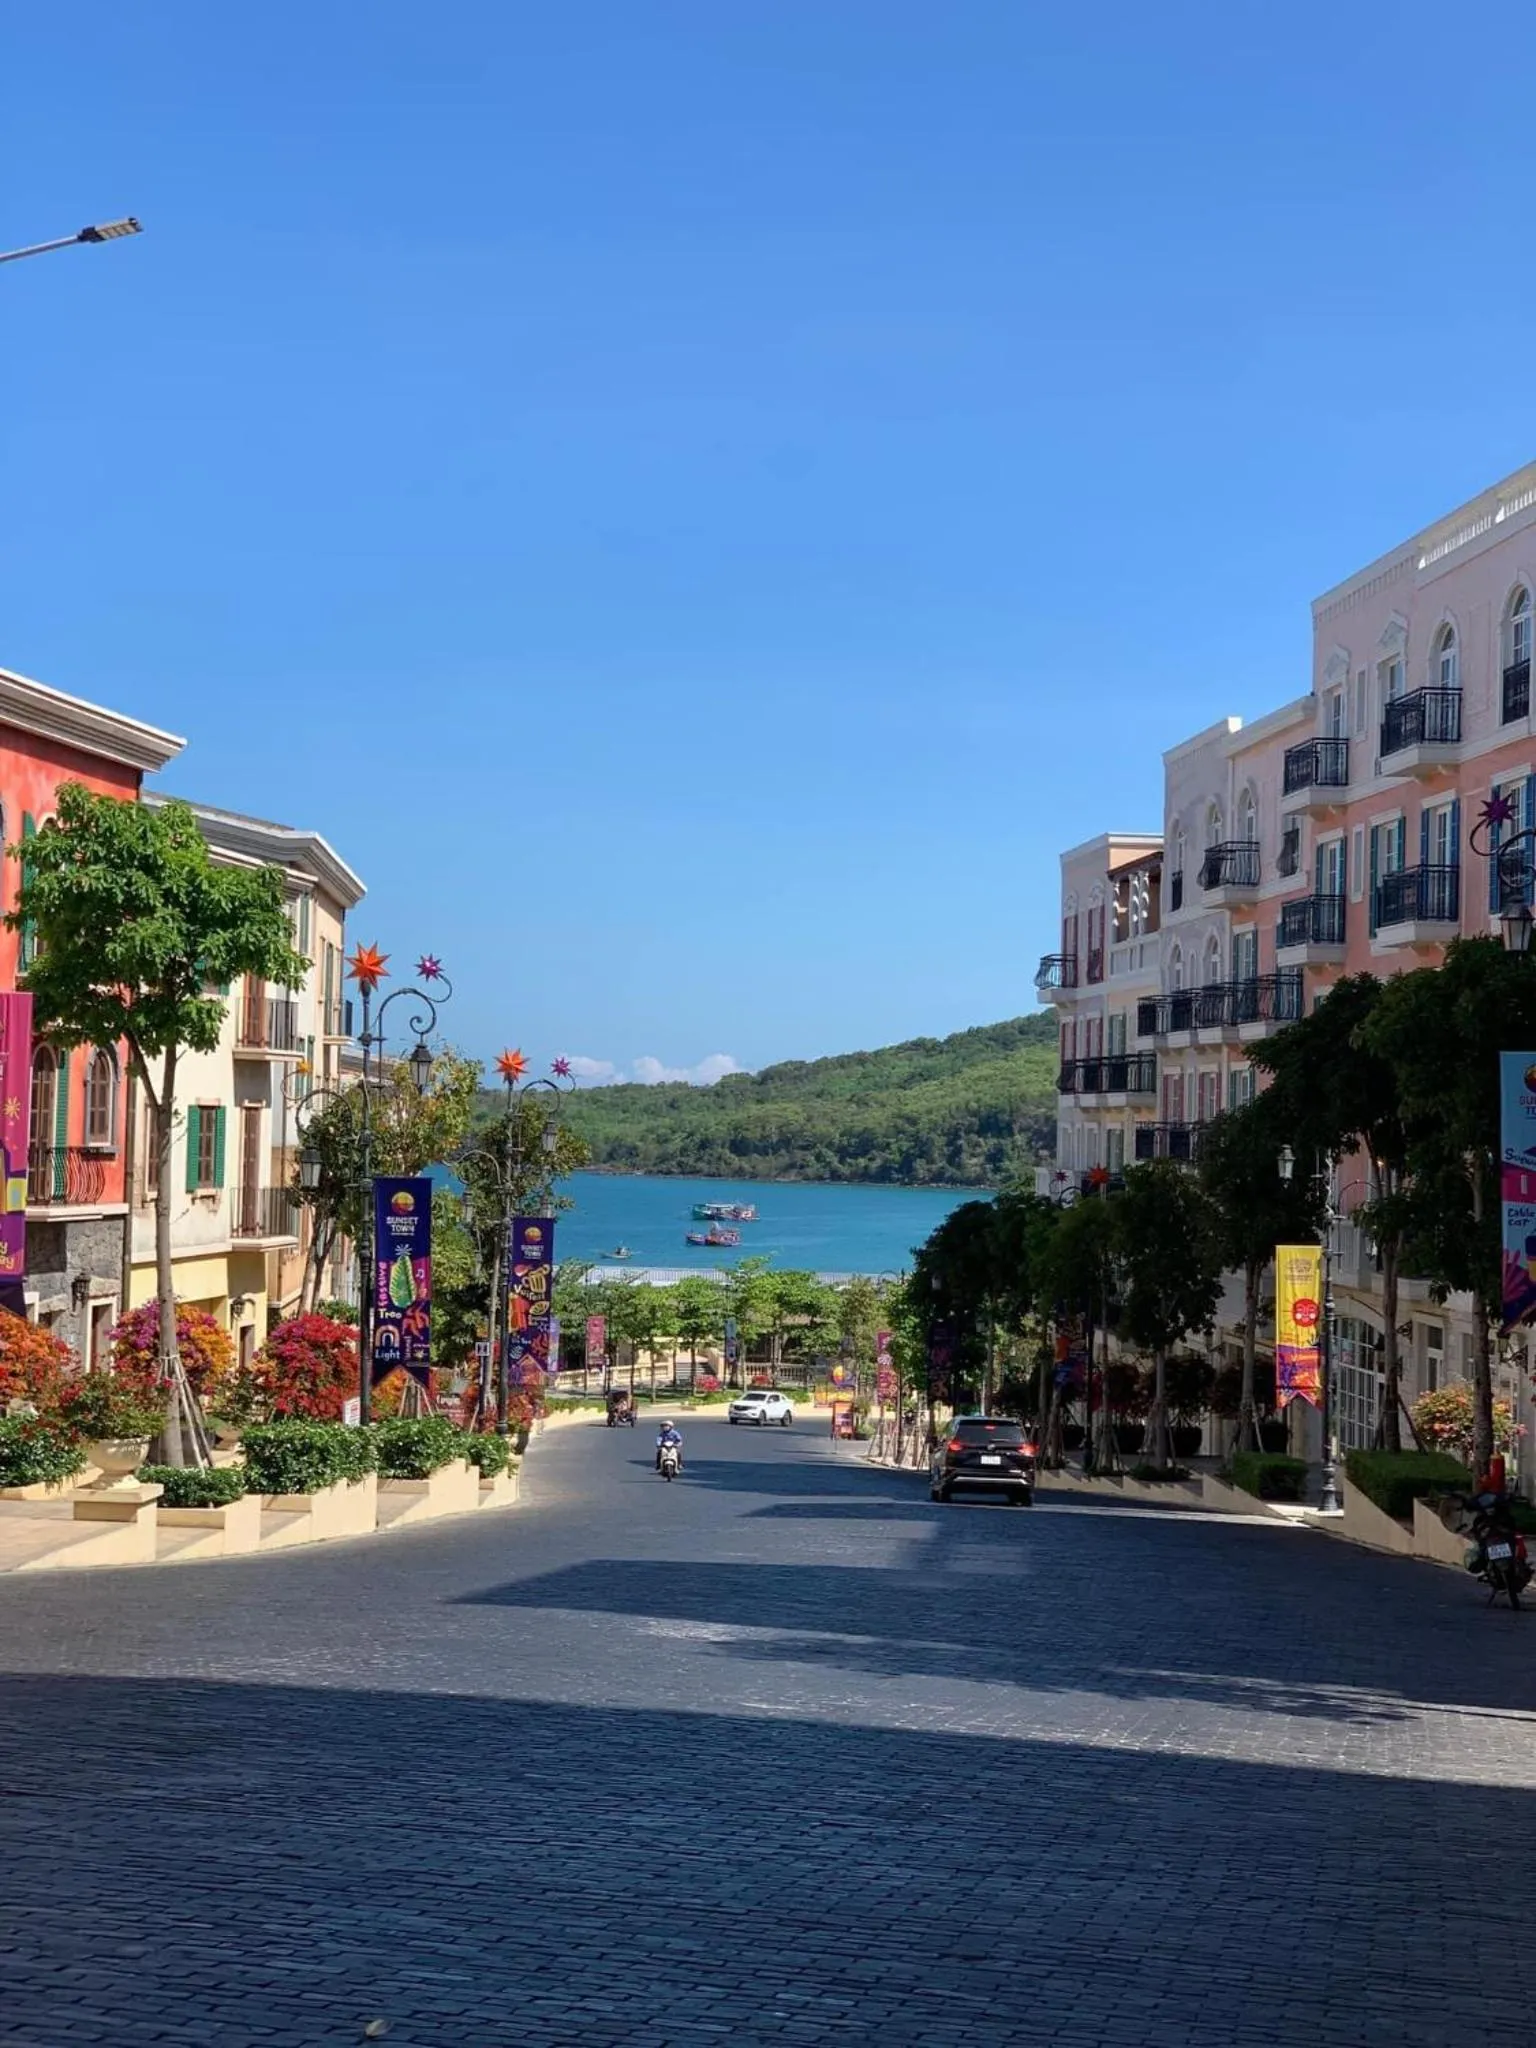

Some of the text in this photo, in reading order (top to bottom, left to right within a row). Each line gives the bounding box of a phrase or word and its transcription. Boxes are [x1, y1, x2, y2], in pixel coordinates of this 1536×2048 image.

[386, 1216, 418, 1226] SUNSET
[391, 1224, 415, 1233] TOWN
[375, 1348, 401, 1361] Light
